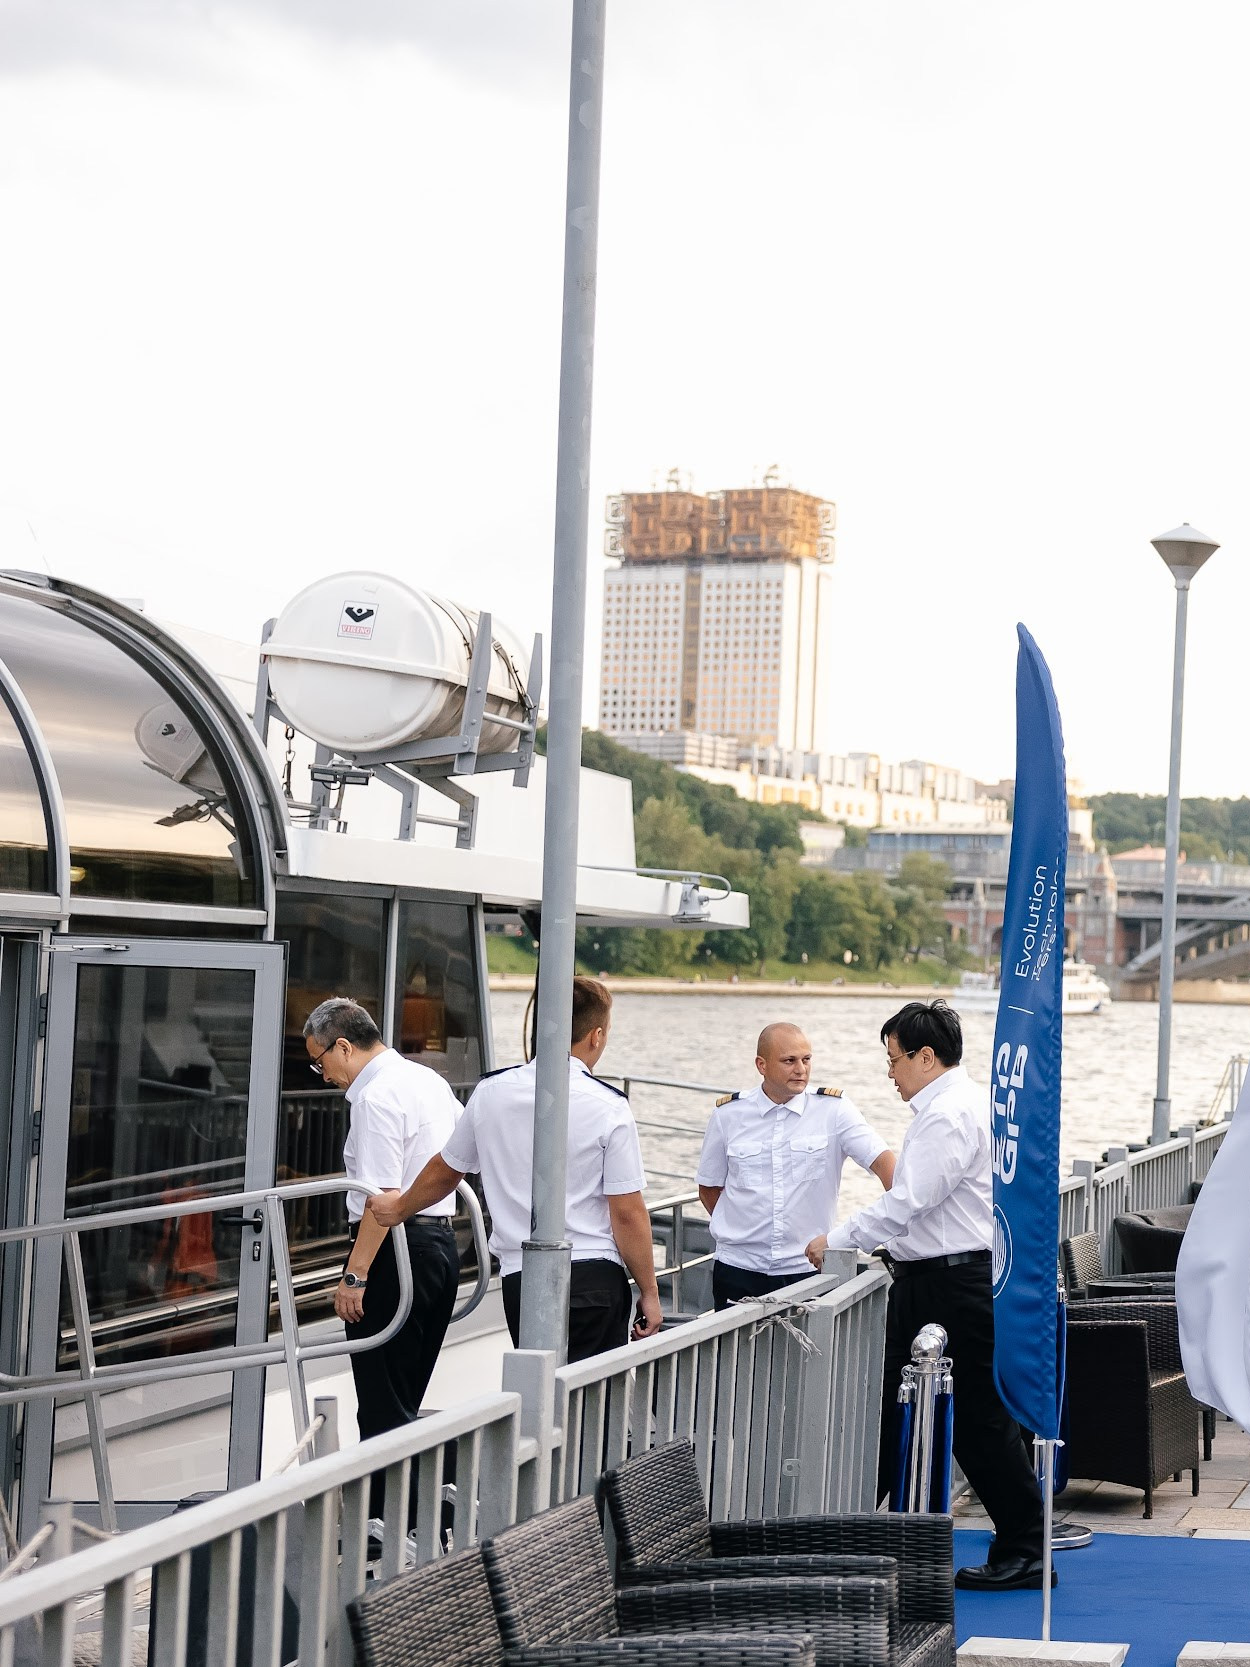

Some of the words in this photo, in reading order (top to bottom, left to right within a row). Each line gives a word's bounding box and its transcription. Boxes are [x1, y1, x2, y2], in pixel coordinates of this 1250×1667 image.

[341, 624, 371, 635] VIKING
[1014, 865, 1048, 978] Evolution
[999, 1044, 1029, 1185] GPB
